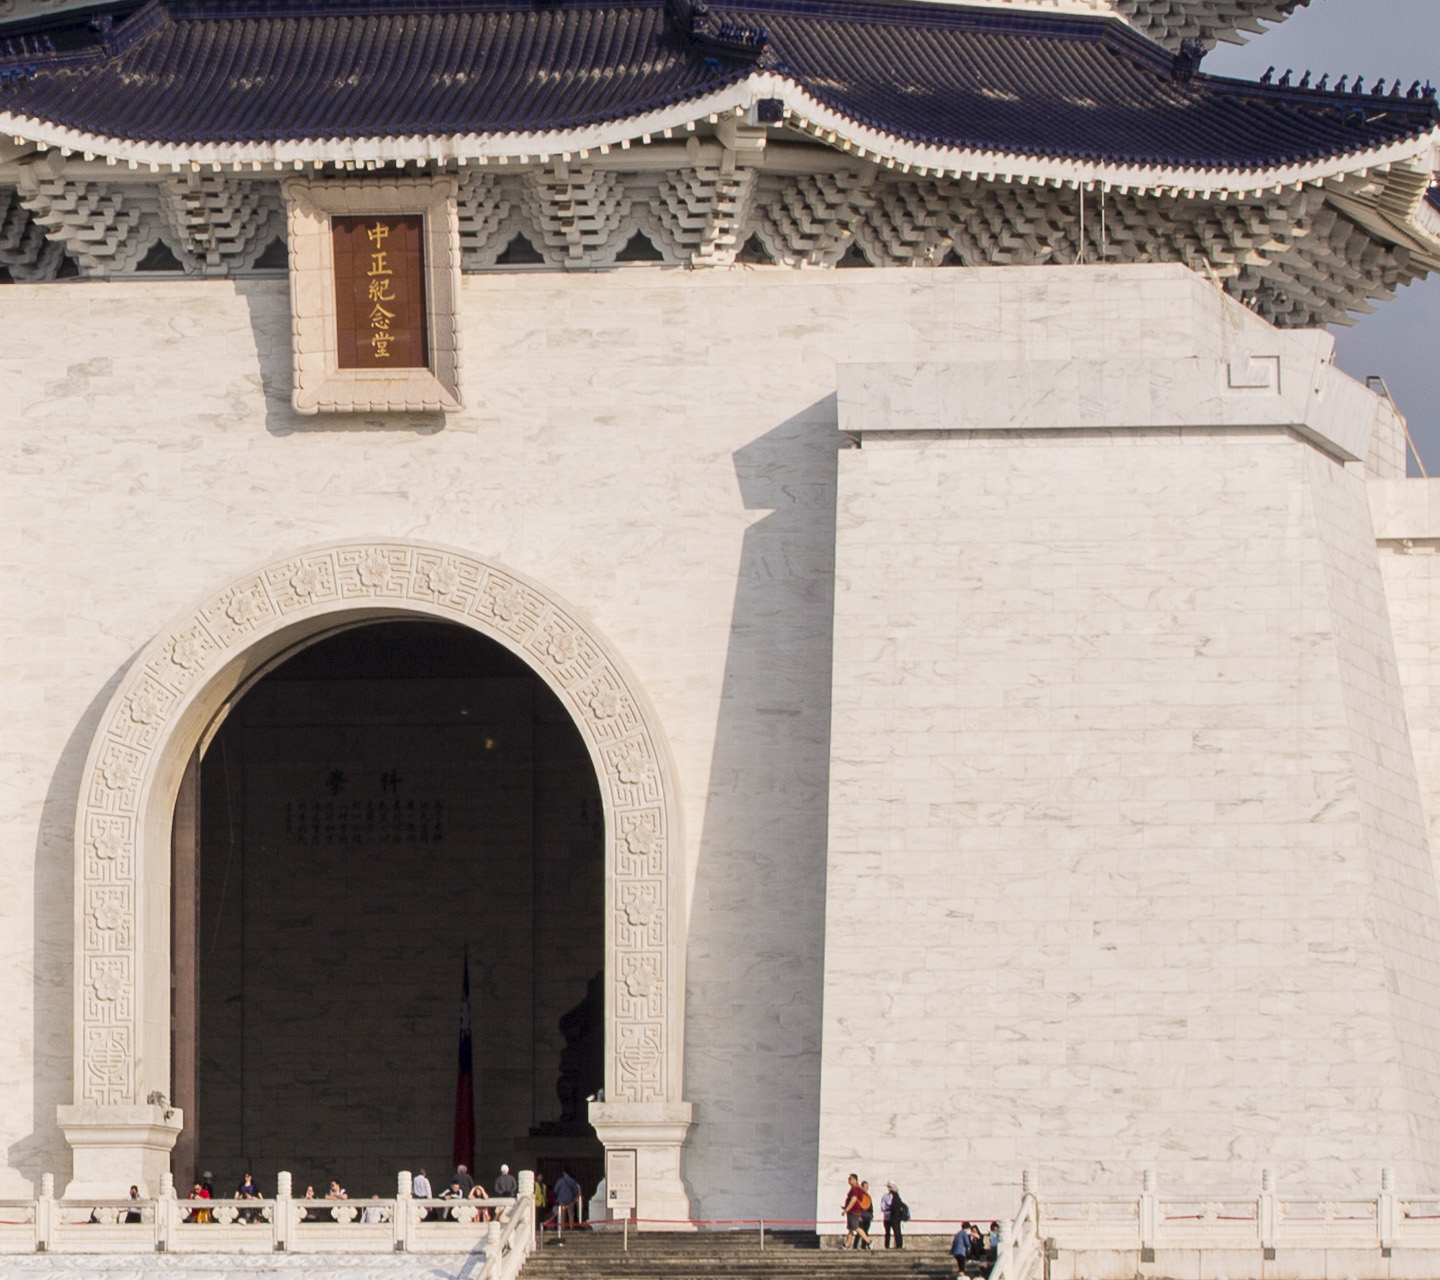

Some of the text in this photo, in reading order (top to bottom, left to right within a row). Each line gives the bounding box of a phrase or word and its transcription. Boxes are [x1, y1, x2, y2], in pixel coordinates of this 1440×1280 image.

[366, 221, 396, 359] 中正紀念堂
